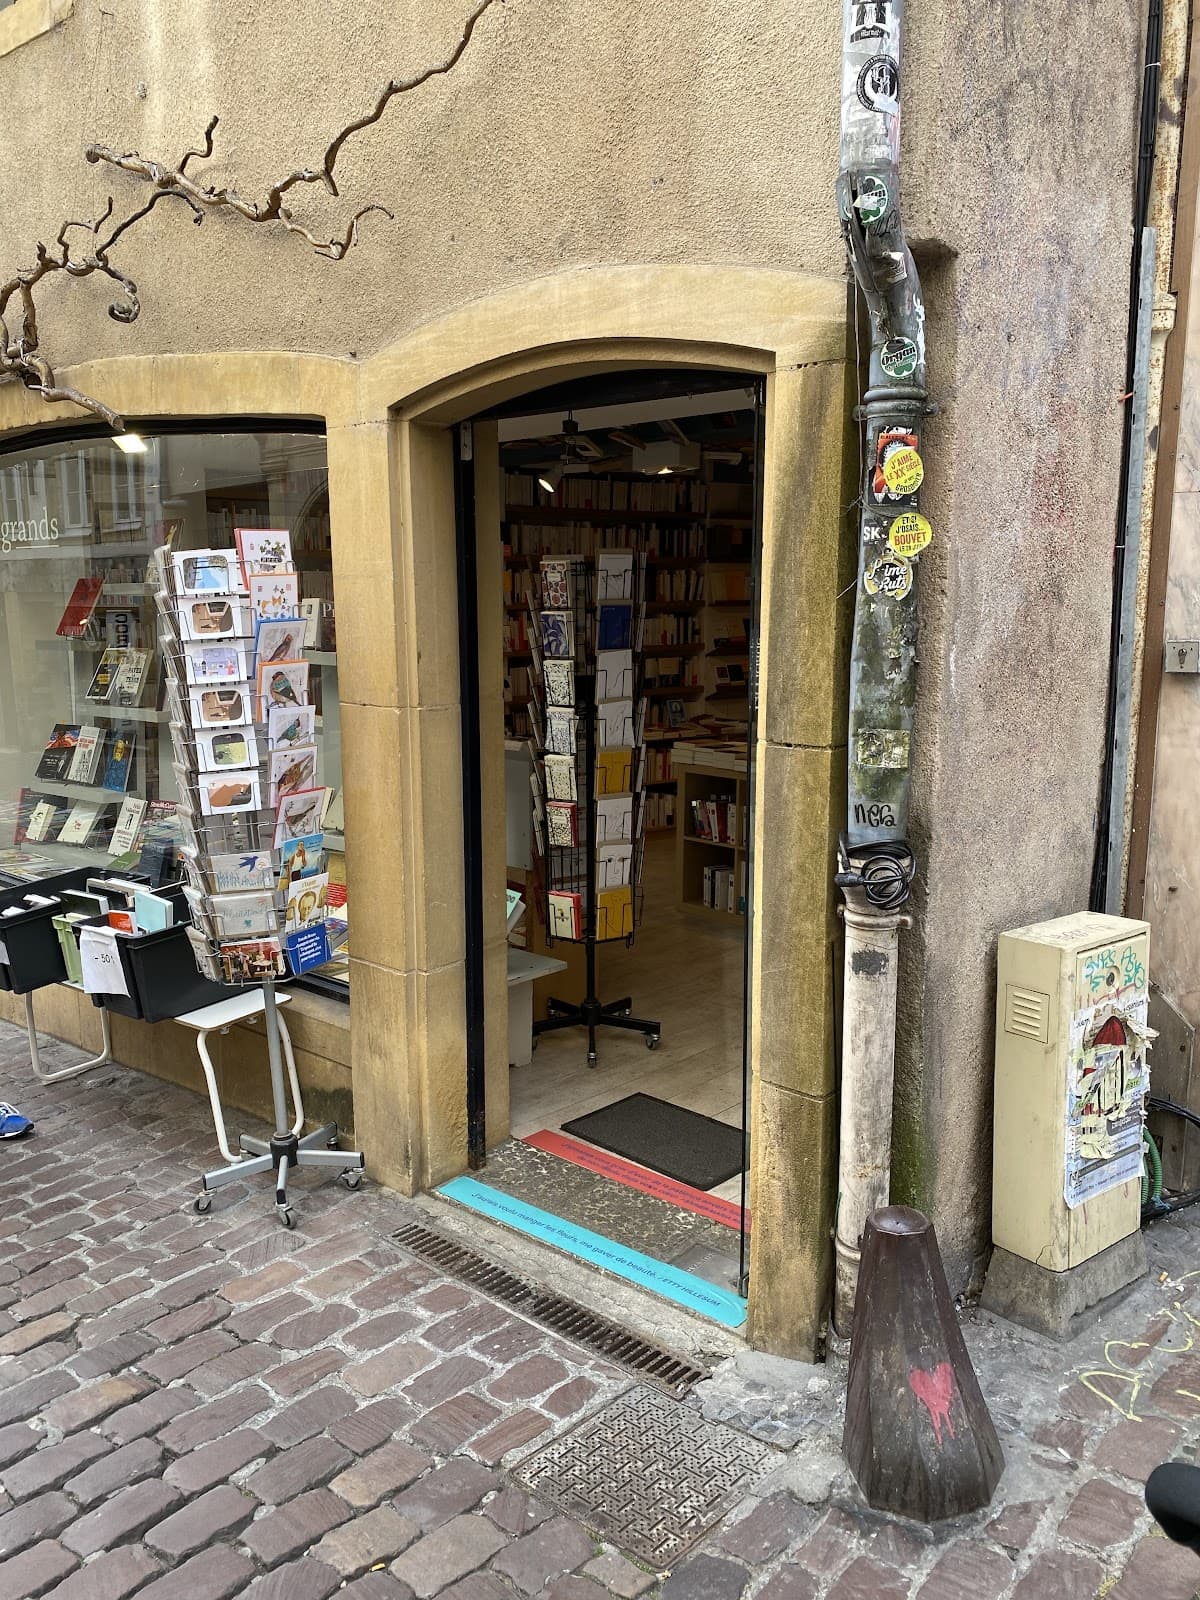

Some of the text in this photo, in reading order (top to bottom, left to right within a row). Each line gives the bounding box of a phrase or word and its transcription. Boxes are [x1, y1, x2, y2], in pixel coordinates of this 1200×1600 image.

[882, 346, 916, 366] Organ
[886, 472, 895, 481] LE
[902, 515, 917, 525] ET SI
[1, 505, 60, 554] grands
[894, 531, 927, 546] BOUVET
[498, 1204, 518, 1216] voulu
[516, 1211, 545, 1226] manger
[544, 1223, 556, 1233] les
[578, 1239, 593, 1249] me
[591, 1245, 618, 1261] gaver
[616, 1256, 628, 1264] de
[681, 1285, 722, 1307] HILLESUM
